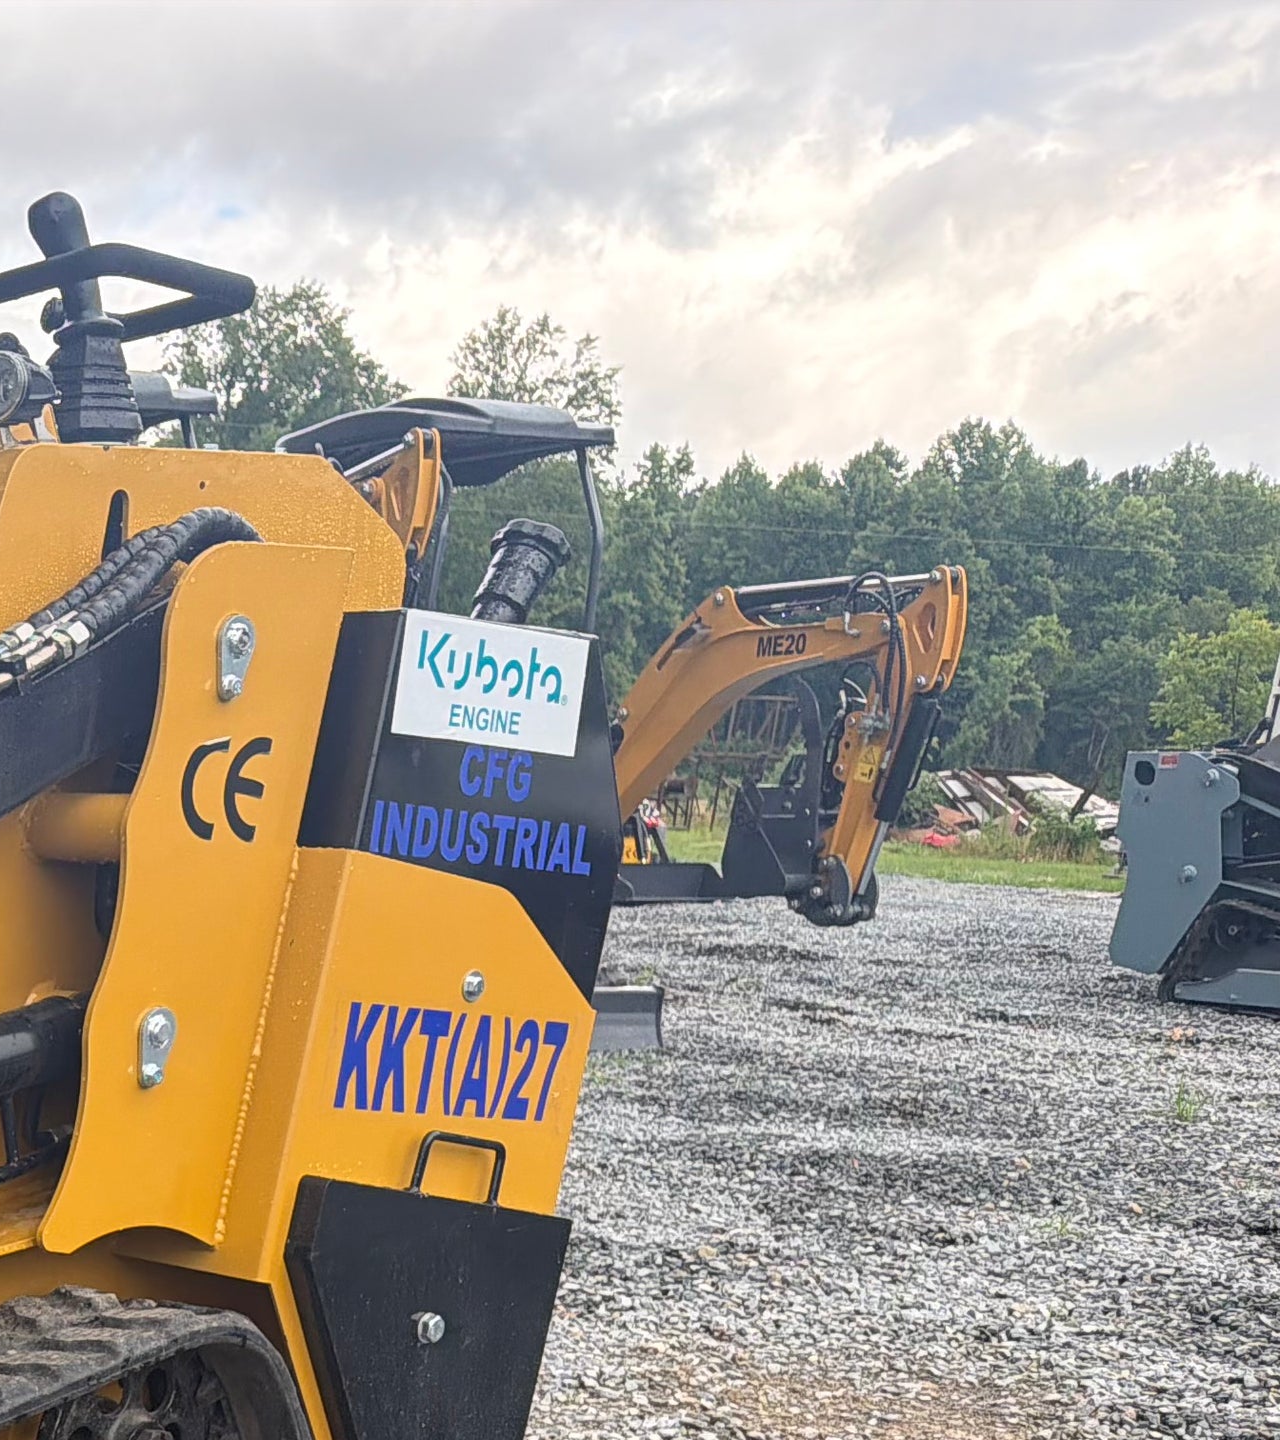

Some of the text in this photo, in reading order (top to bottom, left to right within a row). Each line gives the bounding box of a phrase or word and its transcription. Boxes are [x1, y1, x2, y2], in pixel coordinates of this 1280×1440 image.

[417, 630, 562, 704] Kubota
[756, 633, 807, 658] ME20
[448, 703, 521, 735] ENGINE
[180, 736, 273, 843] CE
[458, 744, 534, 802] CFG
[368, 799, 591, 877] INDUSTRIAL
[333, 1001, 570, 1122] KKT(A)27
